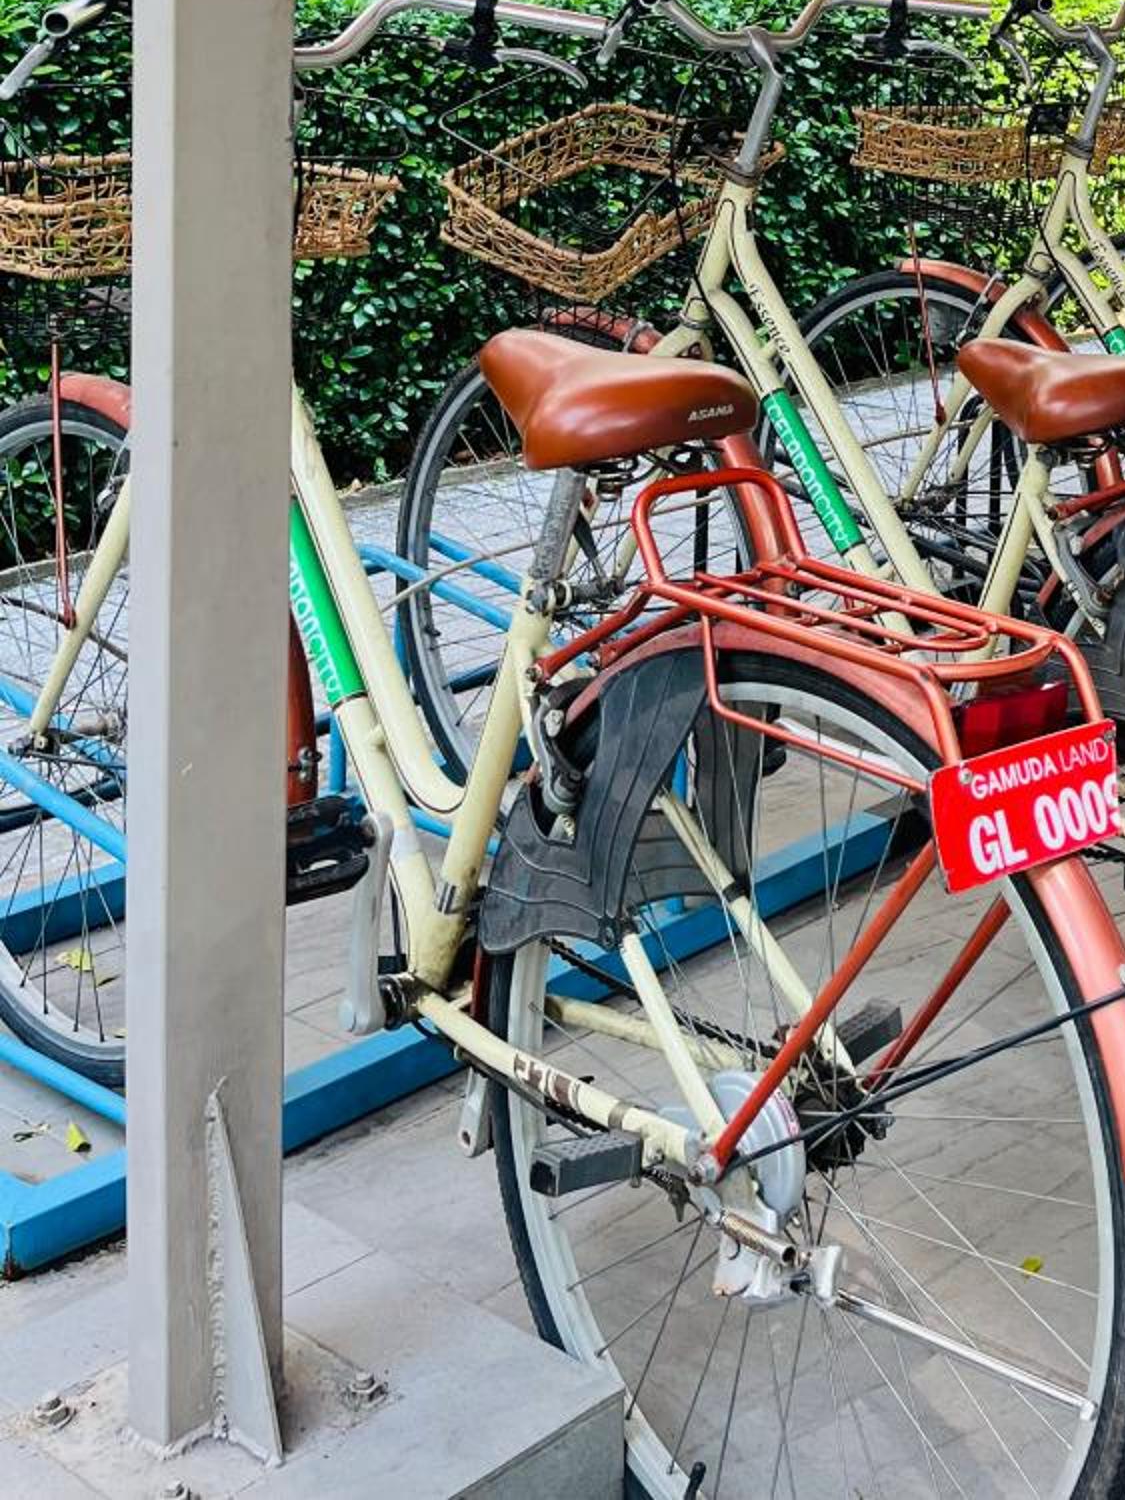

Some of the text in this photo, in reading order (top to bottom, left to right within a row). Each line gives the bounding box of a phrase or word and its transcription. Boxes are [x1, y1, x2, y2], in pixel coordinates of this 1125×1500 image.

[971, 737, 1109, 799] GAMUDA LAND
[969, 810, 1029, 875] GL
